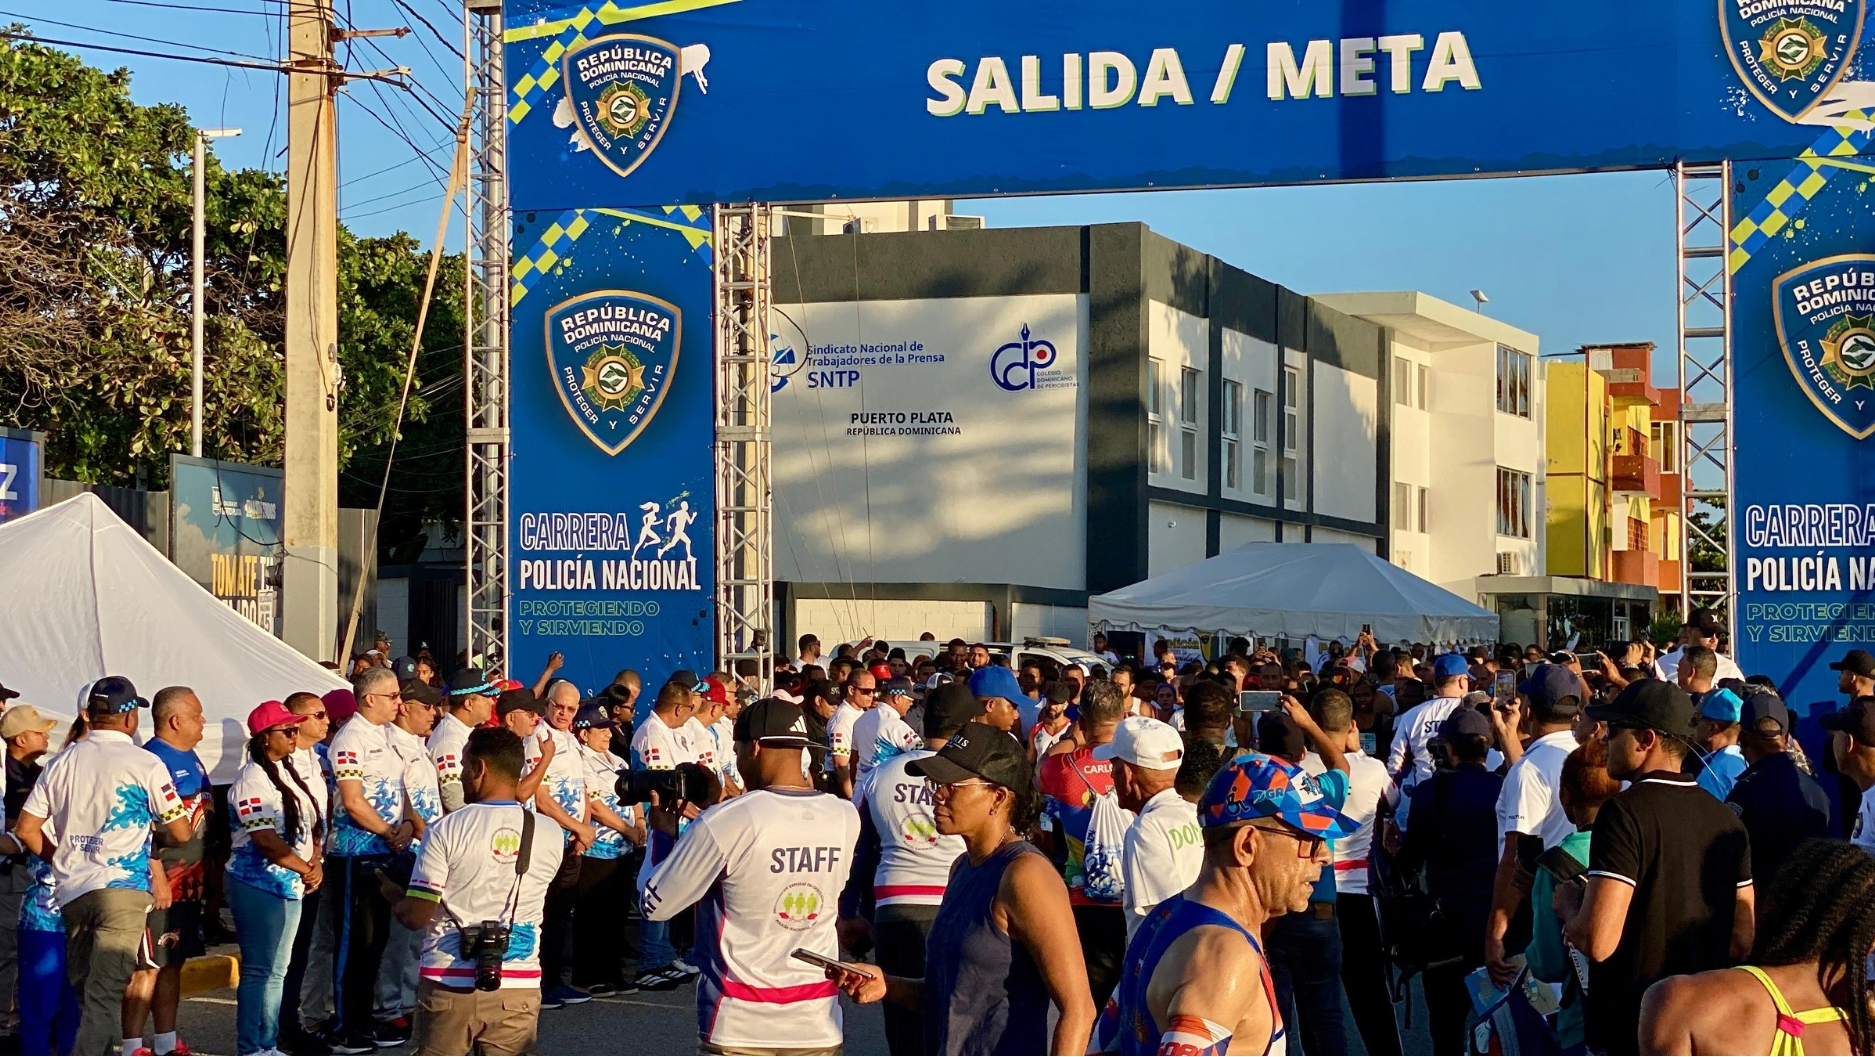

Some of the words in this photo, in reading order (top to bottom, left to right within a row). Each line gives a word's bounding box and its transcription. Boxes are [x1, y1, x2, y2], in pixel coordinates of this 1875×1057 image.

[1790, 7, 1838, 25] NACIONAL
[577, 44, 672, 72] REPÚBLICA
[1740, 40, 1778, 95] PROTEGER
[1789, 90, 1797, 99] Y
[1810, 34, 1847, 93] SERVIR
[580, 59, 665, 82] DOMINICANA
[620, 71, 660, 89] NACIONAL
[926, 47, 1194, 117] SALIDA
[1210, 43, 1246, 104] /
[1266, 30, 1481, 101] META
[580, 101, 612, 151] PROTEGER
[619, 146, 628, 155] Y
[638, 97, 667, 150] SERVIR
[1792, 267, 1875, 302] REPÚB
[1796, 288, 1875, 316] DOMINIC
[561, 302, 670, 333] REPÚBLICA
[564, 321, 662, 345] DOMINICANA
[611, 333, 656, 353] NACIONAL
[807, 344, 857, 354] Sindicato
[860, 341, 907, 353] Nacional
[910, 341, 923, 351] de
[808, 355, 876, 368] Trabajadores
[879, 354, 892, 364] de
[895, 353, 904, 363] la
[908, 353, 945, 363] Prensa
[807, 370, 860, 388] SNTP
[1797, 340, 1842, 405] PROTEGER
[1855, 400, 1865, 411] Y
[564, 366, 599, 425] PROTEGER
[608, 420, 618, 430] Y
[629, 364, 664, 425] SERVIR
[851, 413, 906, 424] PUERTO
[911, 412, 953, 423] PLATA
[846, 426, 896, 436] REPÚBLICA
[898, 427, 961, 436] DOMINICANA
[0, 464, 17, 500] Z
[520, 513, 630, 551] CARRERA
[211, 554, 258, 597] TOMATE
[520, 554, 596, 590] POLICÍA
[602, 559, 701, 591] NACIONAL
[1747, 551, 1842, 591] POLICÍA
[1850, 557, 1875, 591] NA
[519, 600, 660, 616] PROTEGIENDO
[1747, 603, 1875, 620] PROTEGIE
[519, 620, 533, 635] Y
[537, 620, 644, 636] SIRVIENDO
[1746, 625, 1763, 642] Y
[1769, 624, 1875, 642] SIRVIEN
[1424, 720, 1441, 733] ST
[894, 783, 937, 806] STA
[770, 847, 842, 874] STAFF
